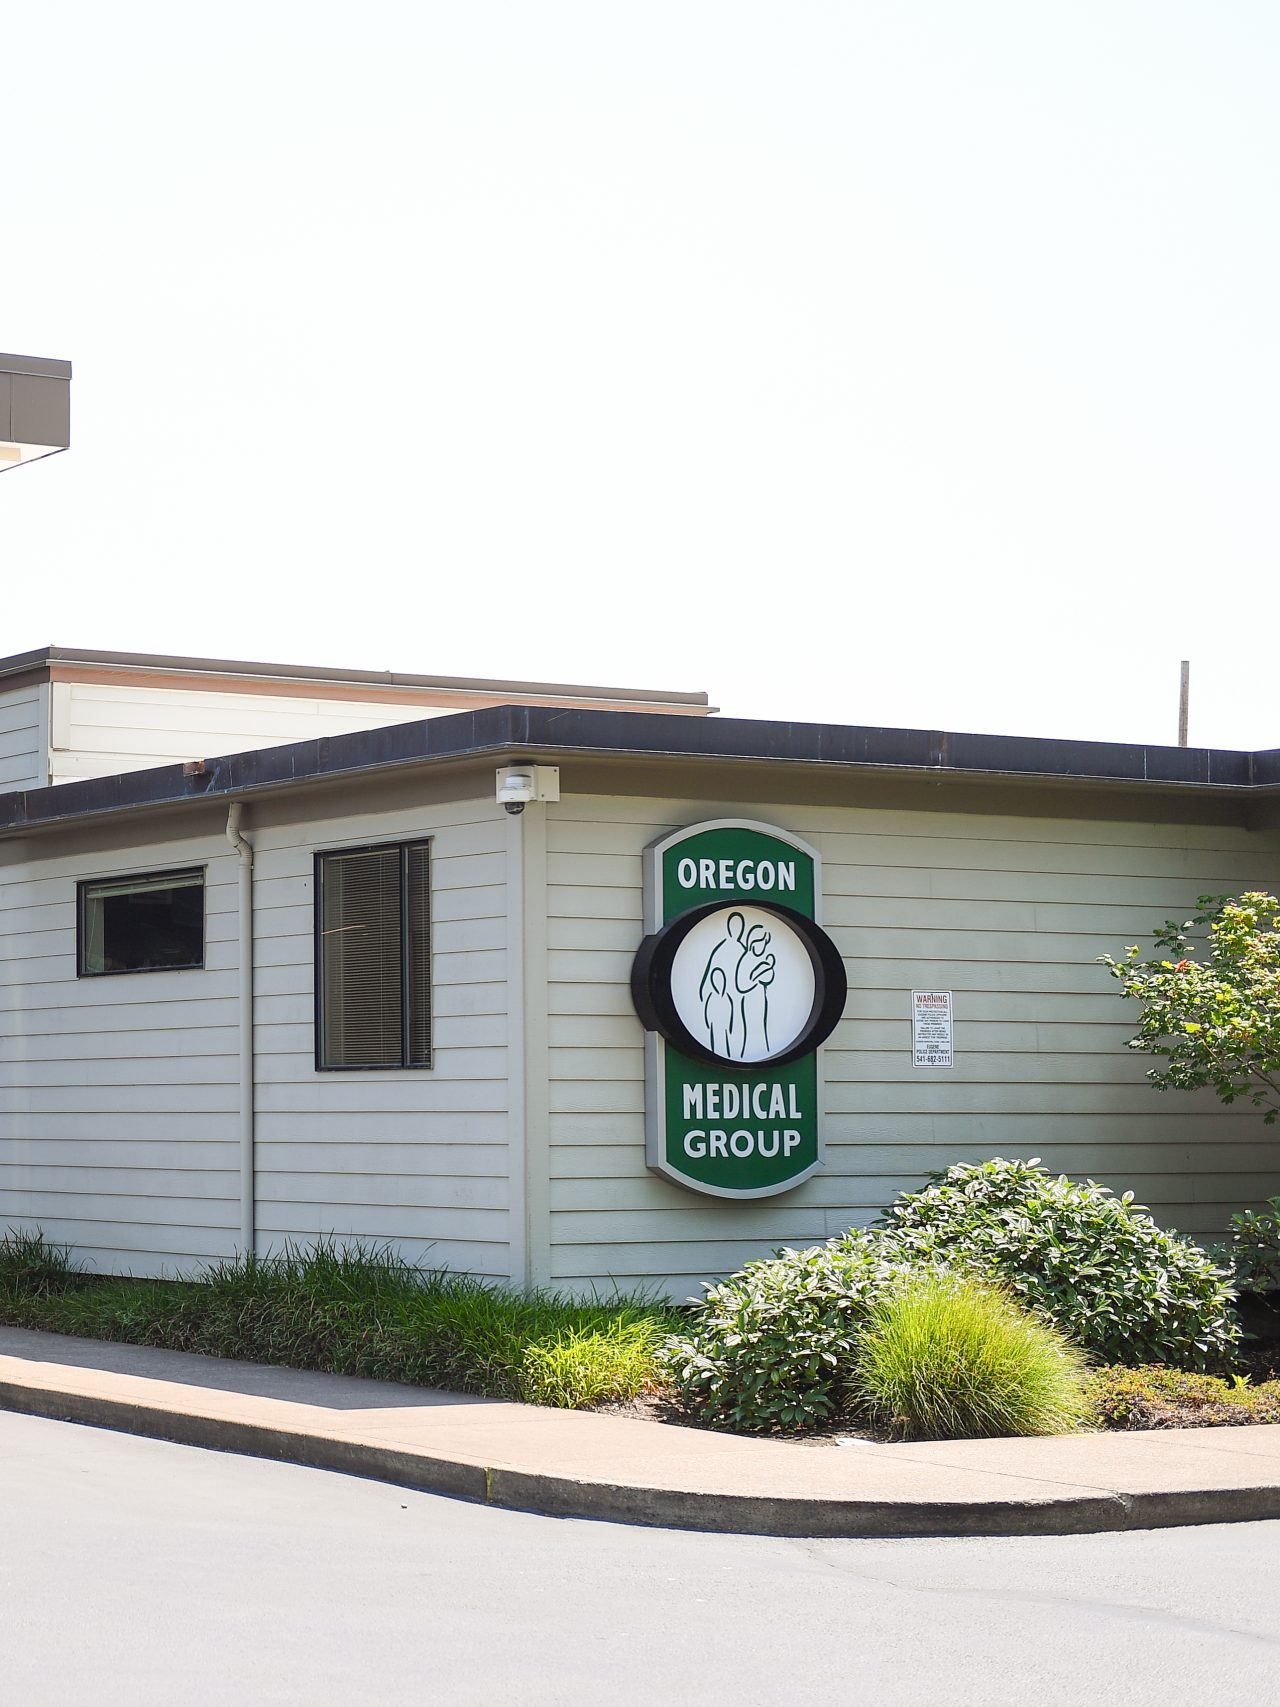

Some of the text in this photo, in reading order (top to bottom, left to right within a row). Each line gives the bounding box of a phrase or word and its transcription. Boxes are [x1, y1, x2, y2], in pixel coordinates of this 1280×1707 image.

[677, 857, 796, 891] OREGON
[916, 994, 948, 1003] WARNING
[682, 1083, 802, 1120] MEDICAL
[683, 1129, 801, 1159] GROUP
